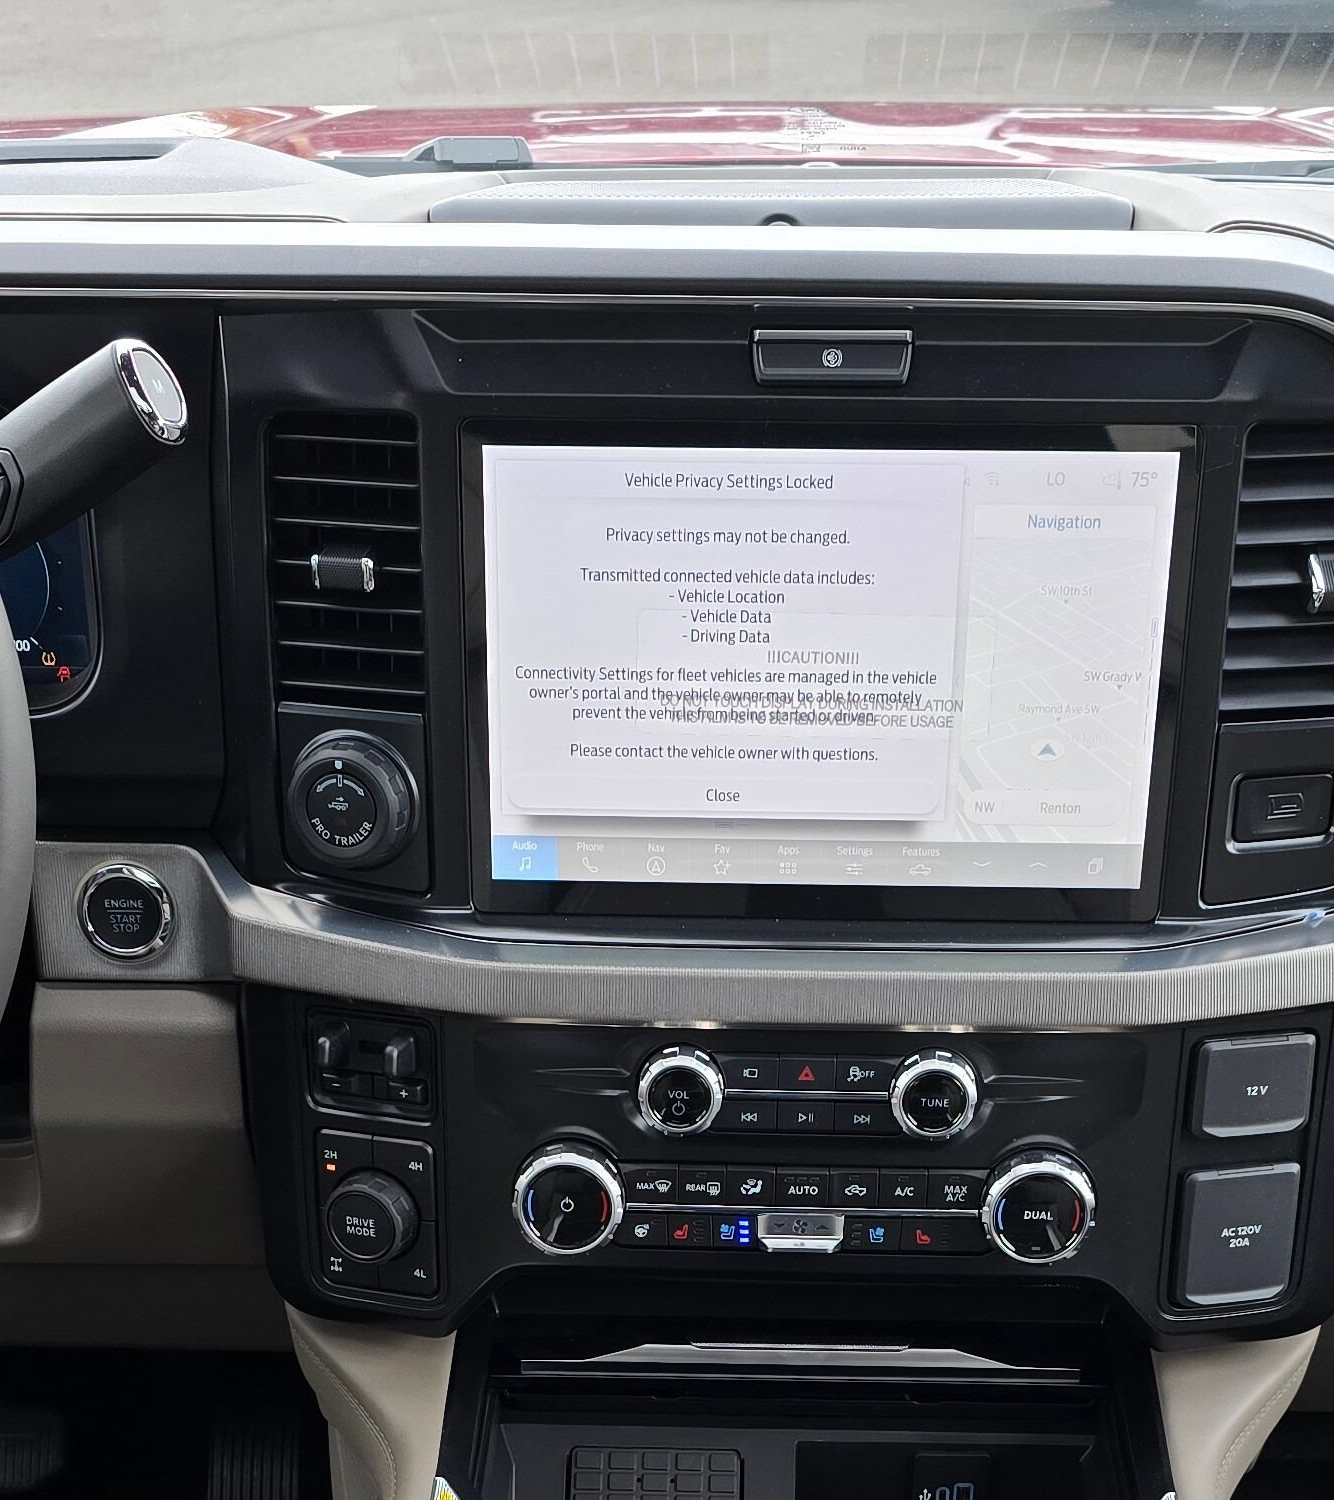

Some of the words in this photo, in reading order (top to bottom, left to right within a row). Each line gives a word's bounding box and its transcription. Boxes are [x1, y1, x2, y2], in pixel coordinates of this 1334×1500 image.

[624, 472, 672, 487] Vehicle
[675, 473, 723, 490] Privacy
[726, 473, 782, 491] Settings
[786, 473, 833, 489] Locked
[1027, 513, 1100, 531] Navigation
[606, 527, 653, 544] Privacy
[656, 528, 709, 545] settings
[713, 531, 741, 545] may
[744, 529, 767, 543] not
[771, 528, 787, 543] be
[790, 529, 849, 546] changed.
[580, 567, 660, 582] Transmitted
[663, 568, 732, 583] connected
[734, 569, 780, 583] vehicle
[783, 569, 814, 584] data
[817, 570, 874, 584] includes:
[677, 588, 724, 603] Vehicle
[727, 589, 784, 603] Location
[690, 608, 736, 623] Vehicle
[740, 609, 771, 623] Data
[690, 628, 735, 645] Driving
[739, 629, 769, 643] Data
[515, 665, 595, 682] Connectivity
[598, 666, 653, 683] Settings
[656, 667, 674, 681] for
[677, 667, 706, 681] fleet
[710, 668, 761, 682] vehicles
[764, 672, 785, 682] are
[788, 669, 849, 686] managed
[852, 670, 863, 683] in
[866, 670, 888, 683] the
[891, 670, 936, 684] vehicle
[529, 685, 578, 699] owner's
[582, 686, 620, 702] portal
[623, 686, 648, 700] and
[675, 687, 719, 701] vehicle
[863, 689, 923, 705] remotely
[572, 706, 621, 720] prevent
[625, 705, 646, 719] the
[910, 714, 955, 728] USAGE
[570, 743, 612, 757] Please
[615, 745, 663, 758] contact
[666, 744, 688, 758] the
[690, 744, 735, 759] vehicle
[738, 748, 778, 759] owner
[780, 746, 809, 760] with
[812, 747, 878, 762] questions.
[706, 788, 740, 801] Close
[974, 801, 995, 813] NW
[1040, 801, 1081, 814] Renton
[311, 816, 330, 840] PRO
[333, 820, 373, 847] TRAILER
[511, 840, 537, 850] Audio
[576, 840, 605, 853] Phone
[647, 843, 665, 853] Nav
[714, 843, 731, 855] Fav
[777, 845, 801, 857] Apps
[902, 846, 940, 856] Features
[836, 845, 874, 858] Settings
[104, 899, 144, 909] ENGINE
[109, 914, 141, 924] START
[112, 923, 140, 933] STOP
[858, 1070, 875, 1079] OFF
[668, 1090, 690, 1100] VOL
[920, 1098, 950, 1108] TUNE
[323, 1150, 338, 1160] 2H
[408, 1161, 423, 1172] 4H
[636, 1182, 655, 1190] MAX
[685, 1183, 706, 1192] REAR
[788, 1185, 819, 1196] AUTO
[894, 1186, 914, 1198] A/C
[944, 1184, 968, 1195] MAX
[945, 1192, 965, 1202] A/C
[345, 1215, 375, 1228] DRIVE
[1023, 1210, 1054, 1221] DUAL
[346, 1225, 376, 1238] MODE
[1221, 1227, 1236, 1238] AC
[1237, 1224, 1262, 1236] 120V
[1229, 1237, 1250, 1248] 20A
[413, 1268, 426, 1279] 4L
